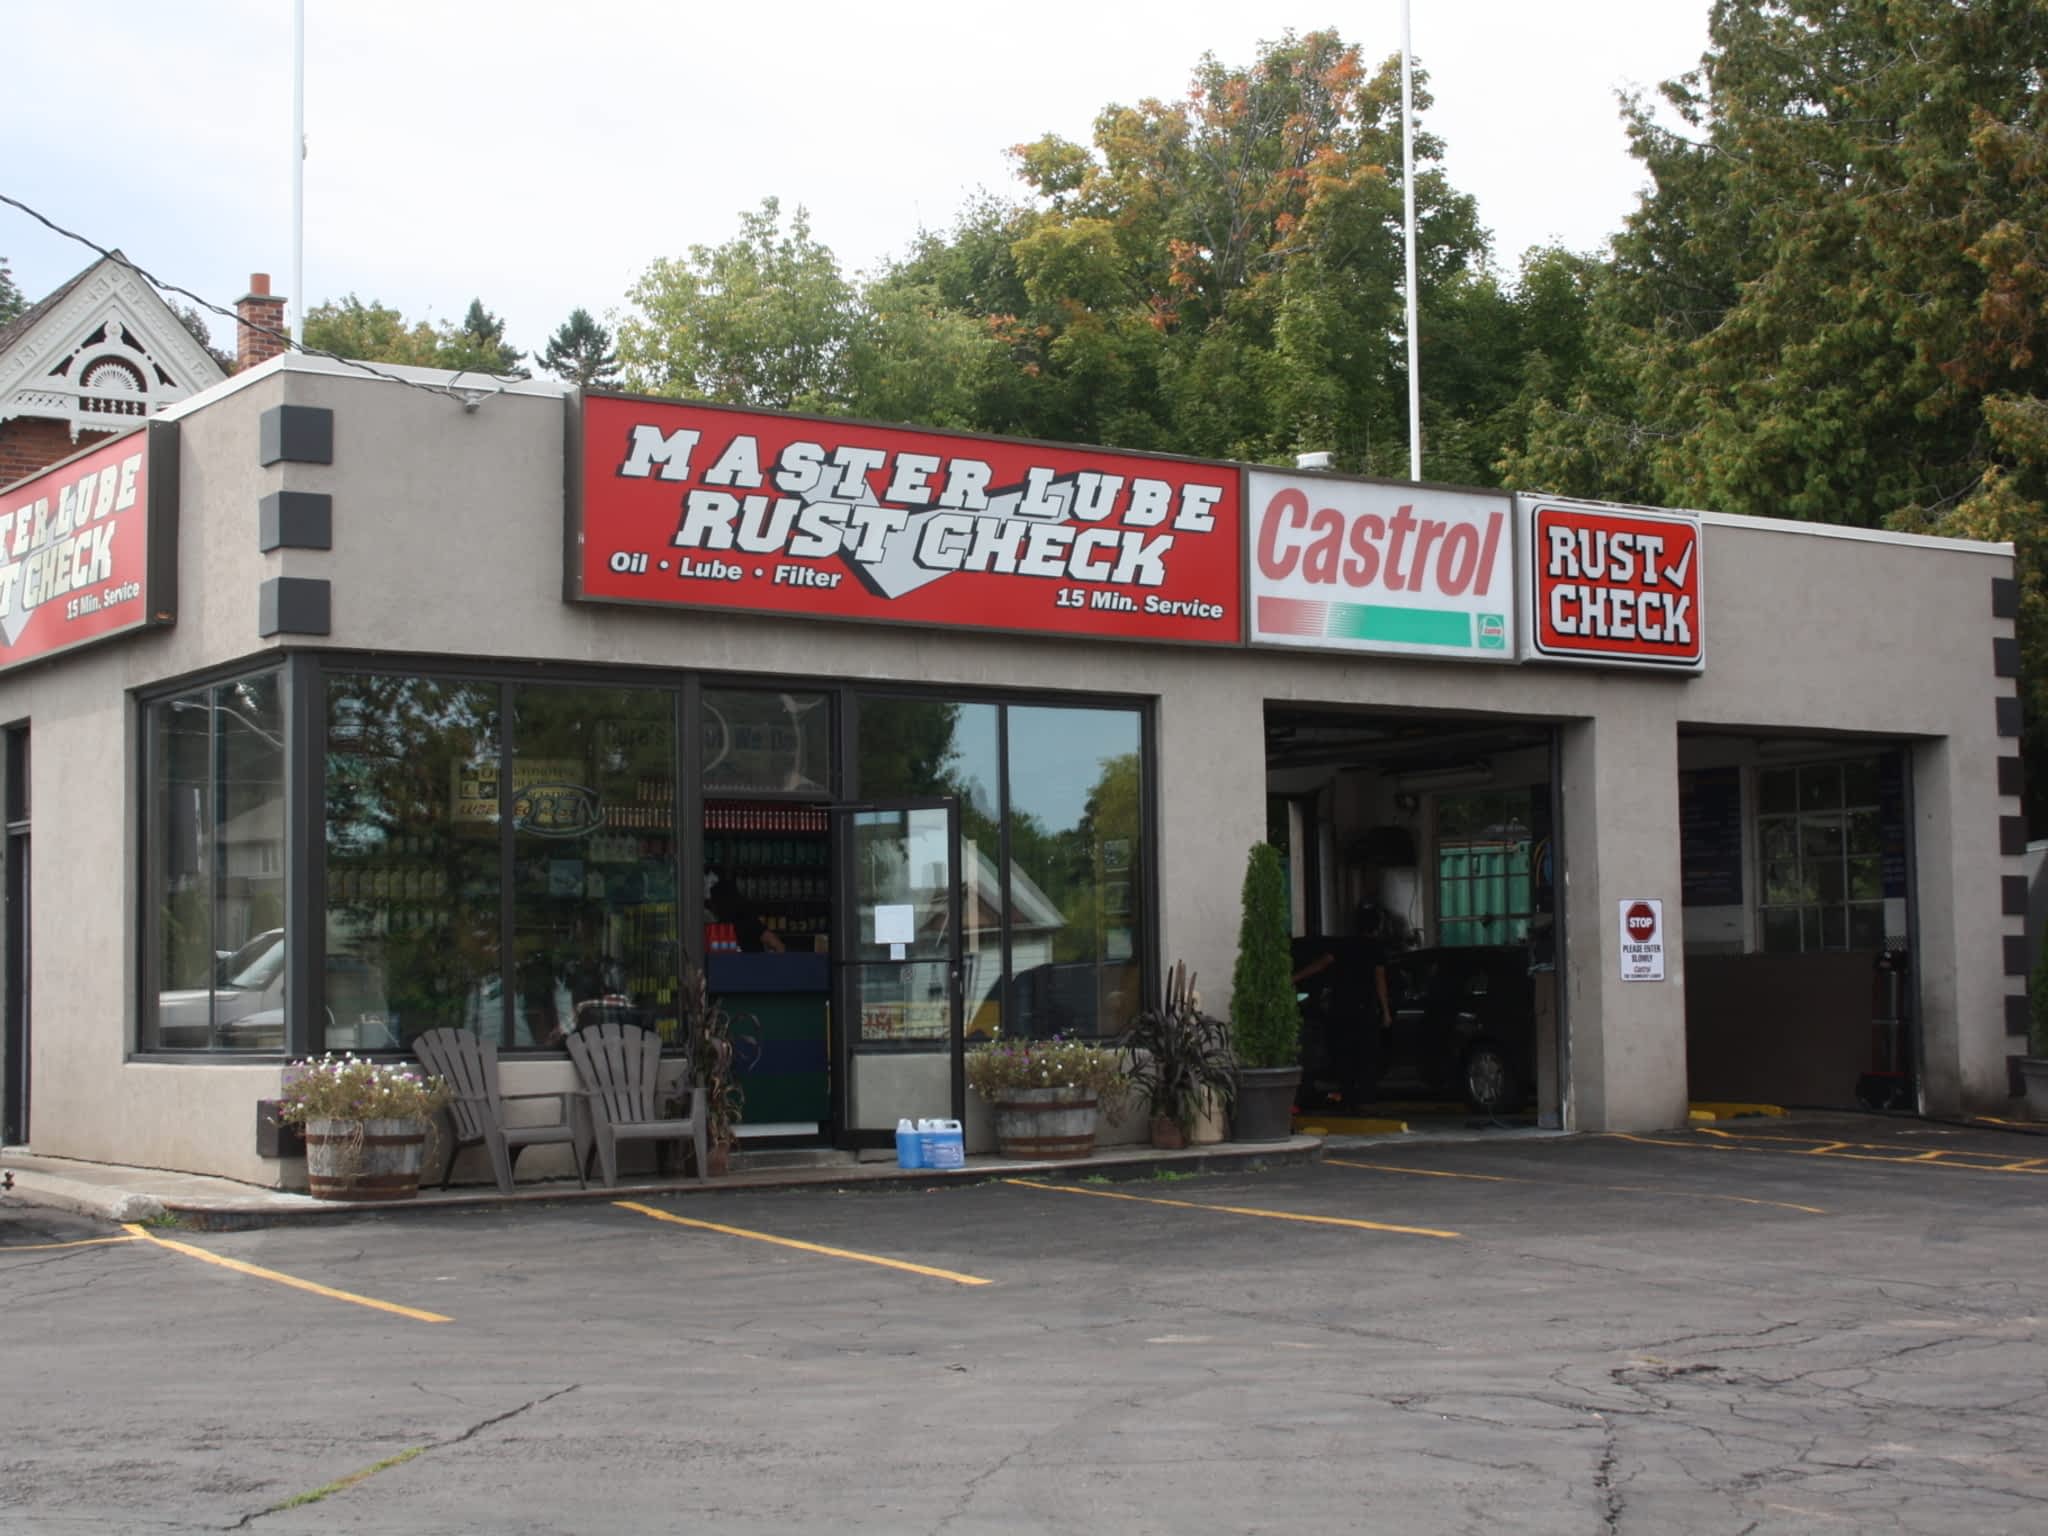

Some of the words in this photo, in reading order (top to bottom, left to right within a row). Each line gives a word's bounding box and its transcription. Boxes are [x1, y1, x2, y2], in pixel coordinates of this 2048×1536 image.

[55, 453, 142, 536] LUBE
[619, 424, 992, 510] MASTER
[1015, 466, 1222, 533] LUBE
[23, 520, 116, 611] CHECK
[674, 490, 909, 563] RUST
[917, 512, 1175, 586] CHECK
[1257, 487, 1504, 597] Castrol
[1547, 524, 1664, 585] RUST
[67, 598, 79, 620] 15
[103, 581, 140, 607] Service
[609, 551, 649, 574] Oil
[679, 556, 744, 581] Lube
[773, 565, 842, 589] Filter
[1056, 588, 1086, 608] 15
[1090, 591, 1138, 612] Min.
[1144, 595, 1224, 619] Service
[1550, 583, 1692, 646] CHECK
[1629, 917, 1653, 929] STOP
